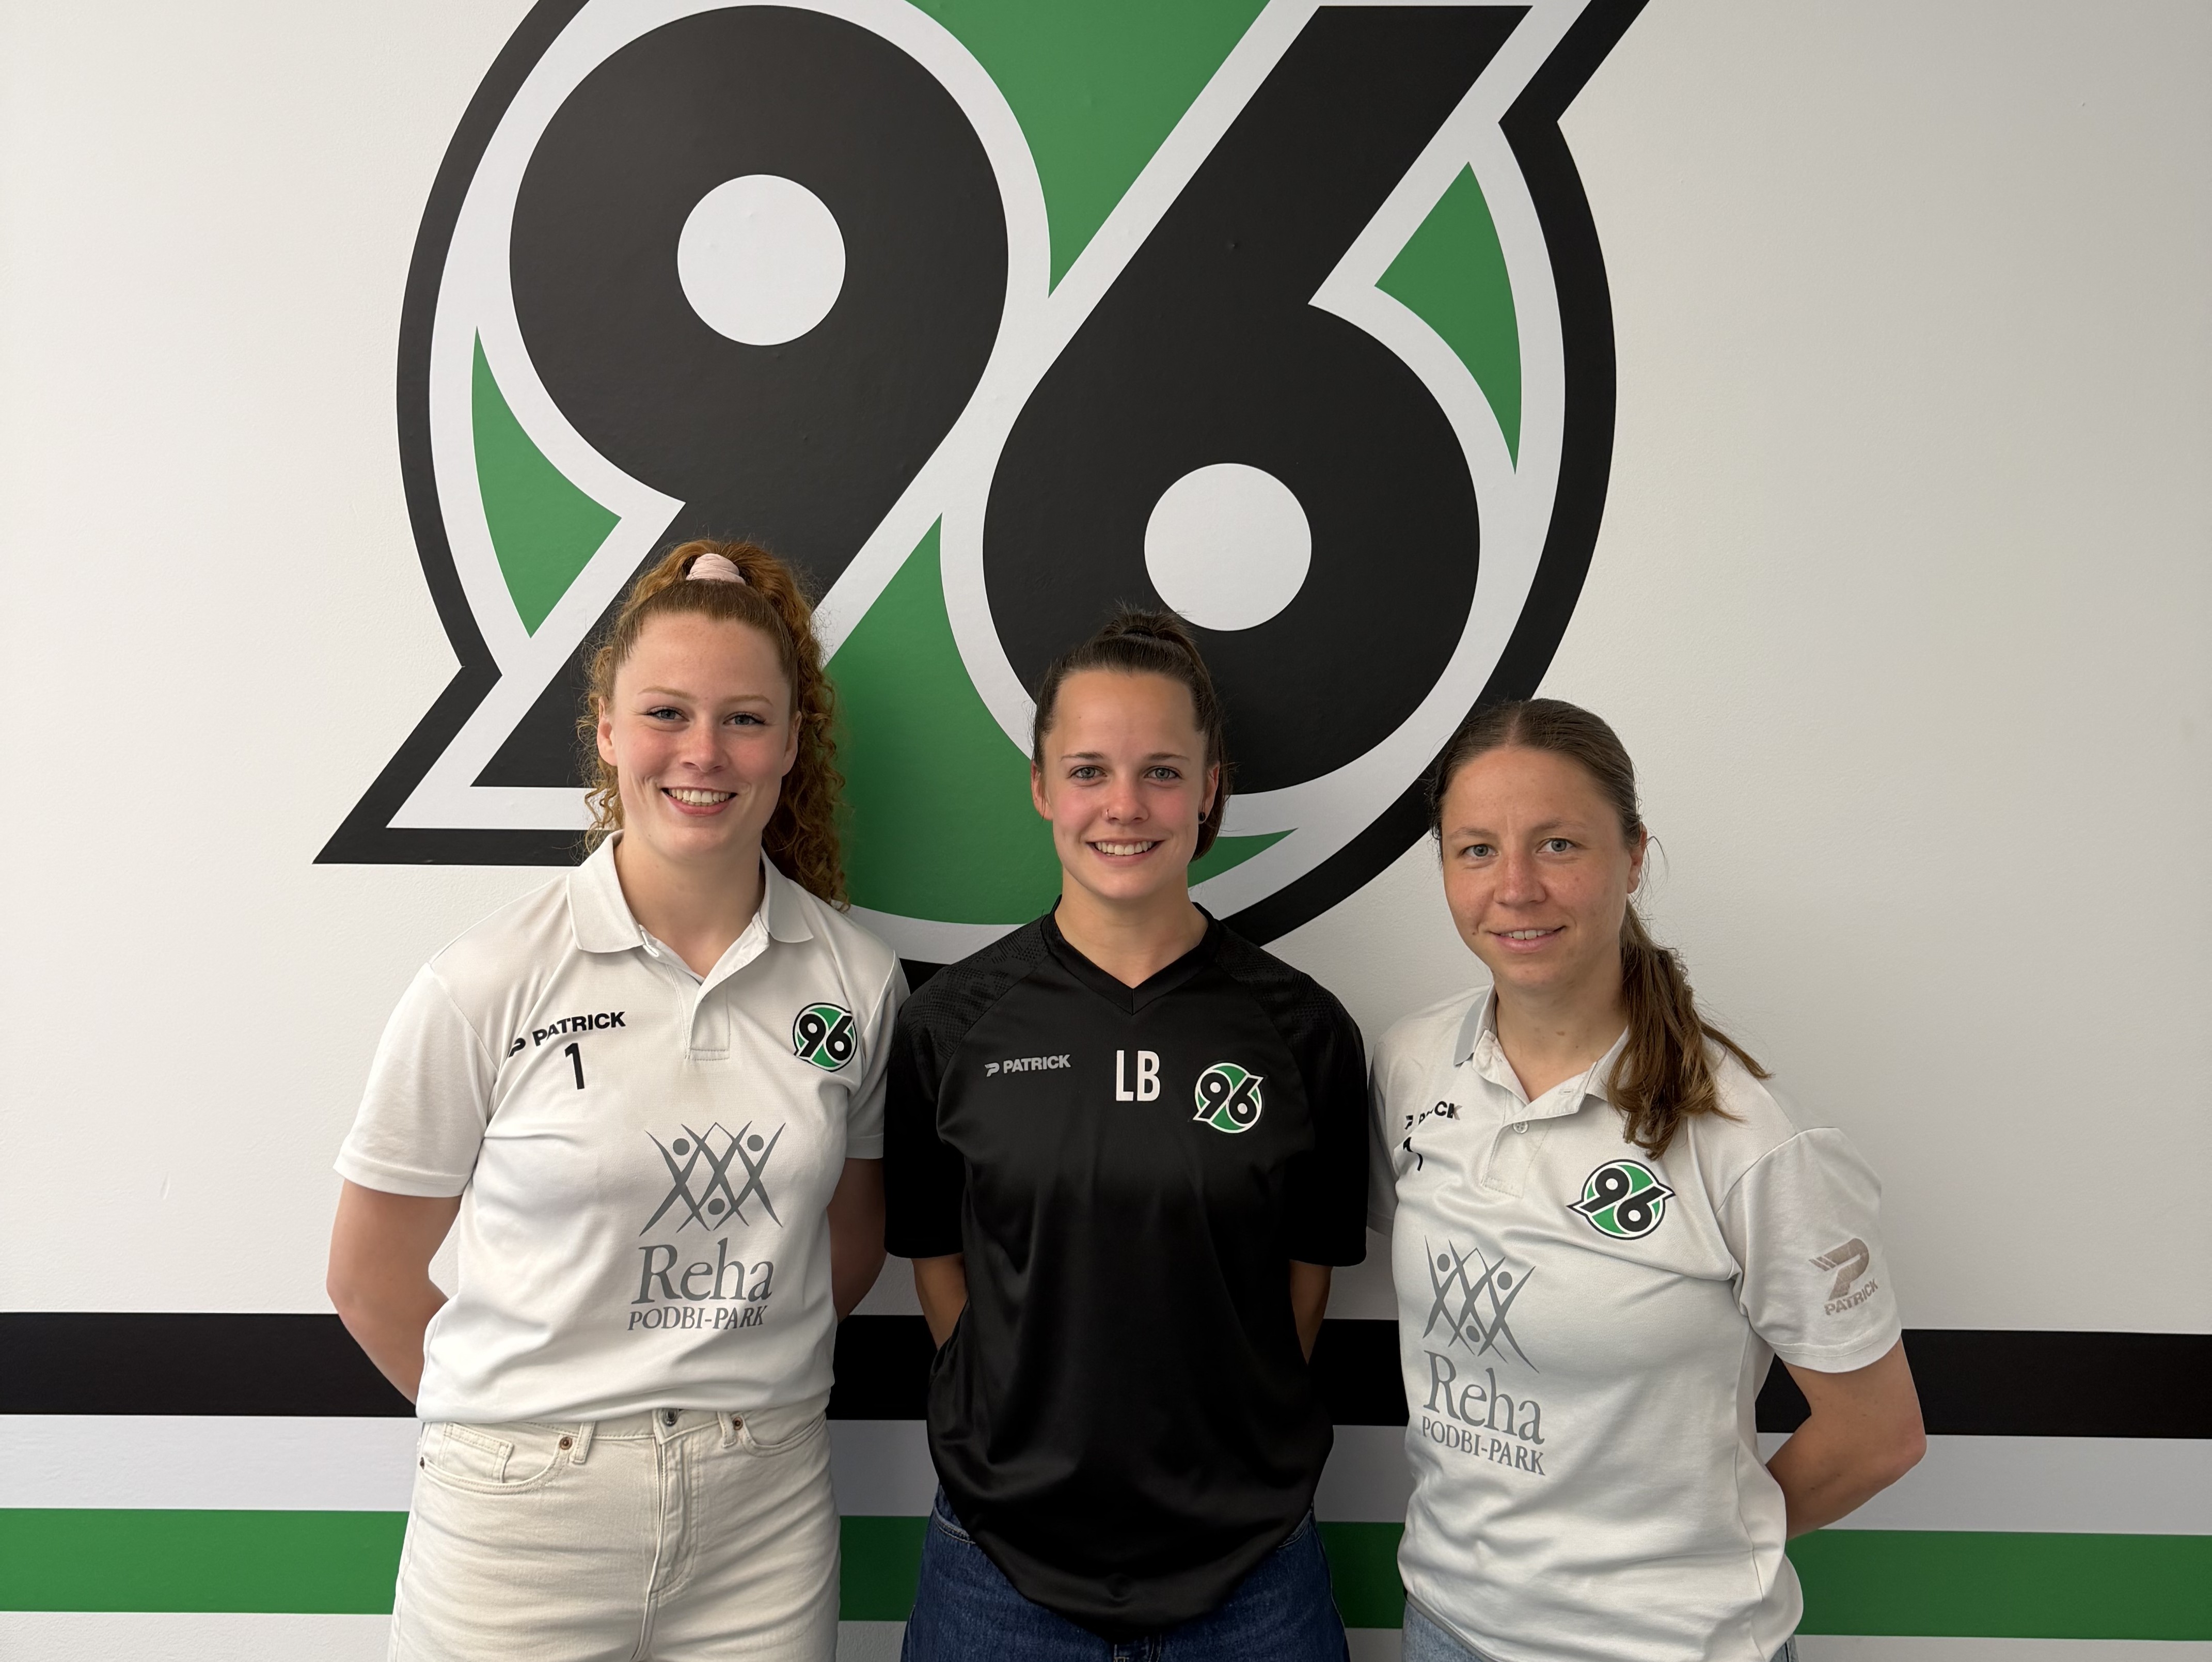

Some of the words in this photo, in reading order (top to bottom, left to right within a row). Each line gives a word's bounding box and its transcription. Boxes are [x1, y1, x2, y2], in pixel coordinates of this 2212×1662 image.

[471, 4, 1533, 795] 96
[532, 1011, 626, 1047] PATRICK
[799, 1013, 853, 1061] 96
[564, 1042, 585, 1090] 1
[1003, 1054, 1071, 1074] PATRICK
[1116, 1049, 1161, 1102] LB
[1198, 1072, 1260, 1125] 96
[1579, 1167, 1667, 1232] 96
[631, 1237, 774, 1305] Reha
[1824, 1278, 1878, 1316] PATRICK
[627, 1305, 768, 1330] PODBI-PARK
[1423, 1350, 1545, 1445] Reha
[1422, 1415, 1546, 1476] PODBI-PARK
